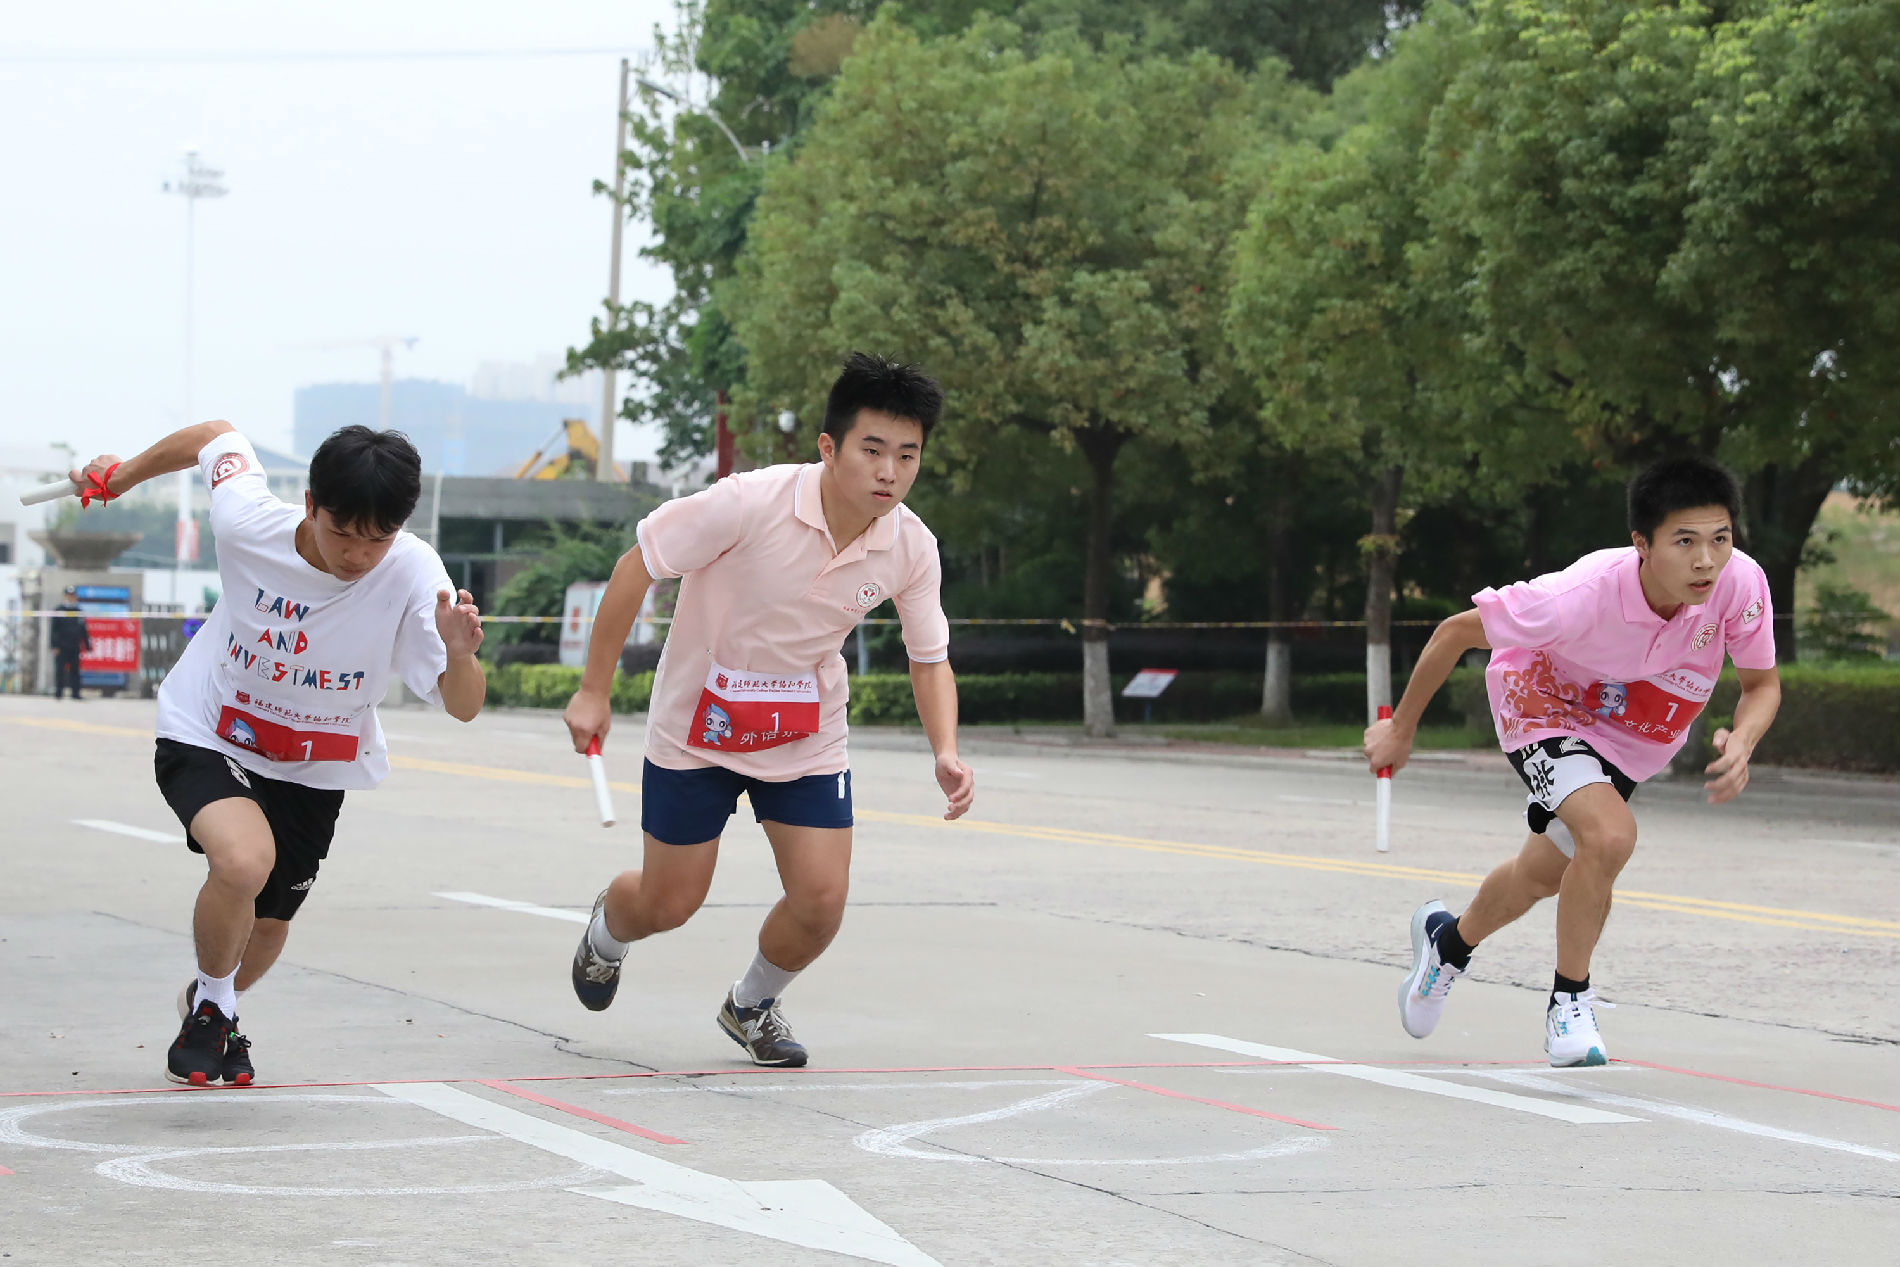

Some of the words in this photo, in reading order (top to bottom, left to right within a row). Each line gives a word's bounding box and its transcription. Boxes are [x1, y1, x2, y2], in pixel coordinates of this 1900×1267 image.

[255, 588, 310, 622] LAW
[257, 628, 309, 655] AND
[771, 711, 781, 733] 1
[1665, 701, 1679, 722] 1
[301, 740, 313, 762] 1
